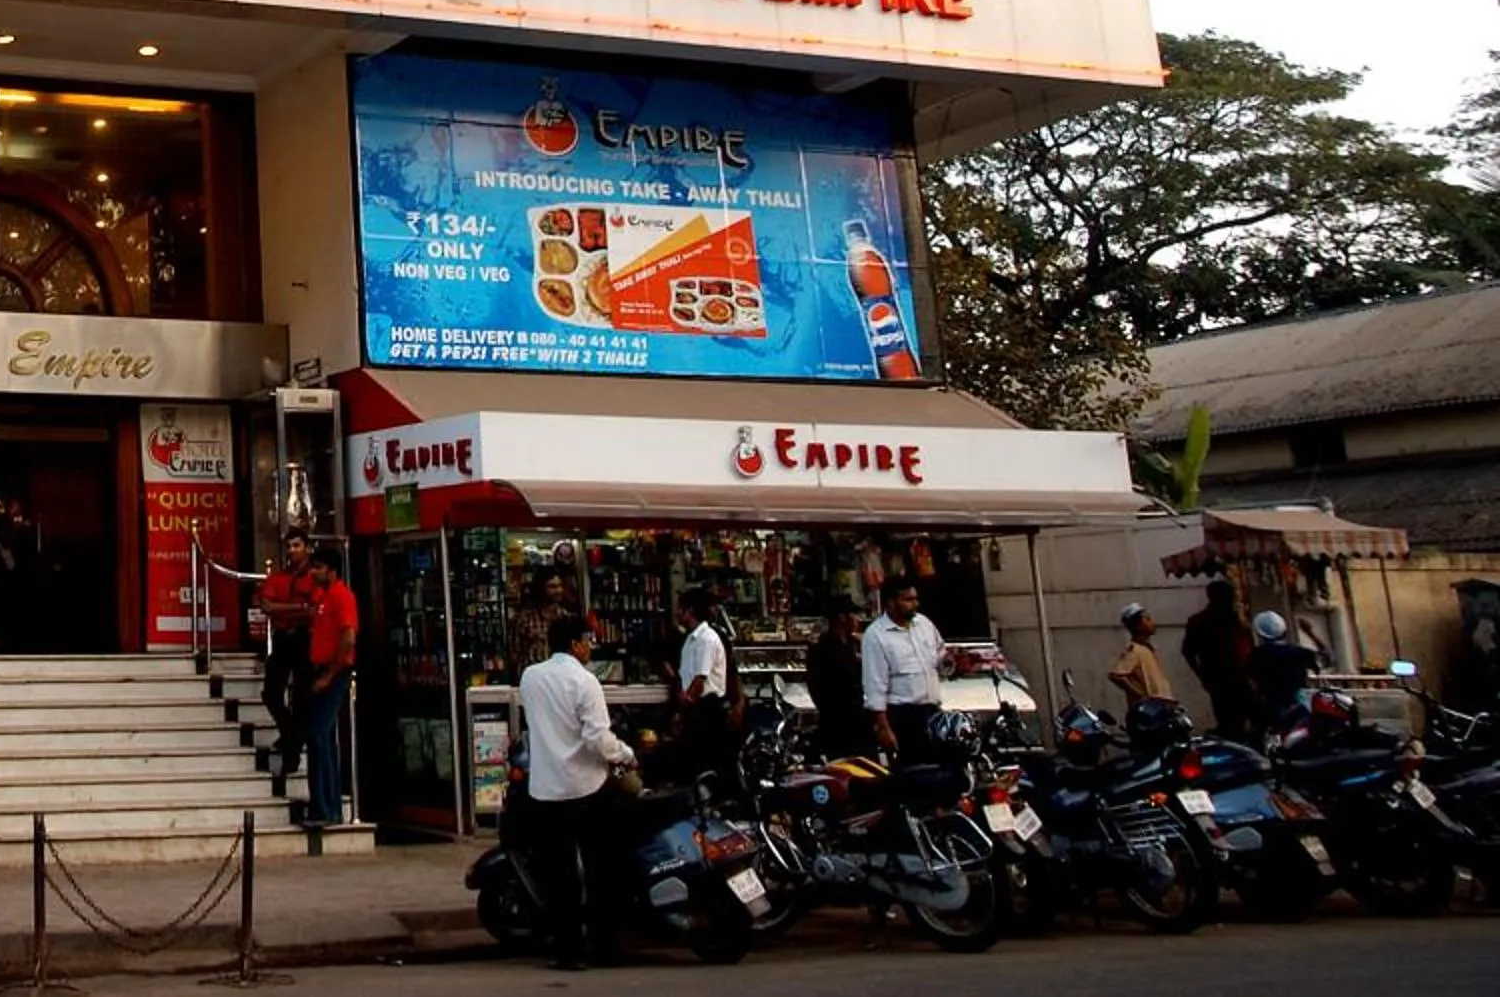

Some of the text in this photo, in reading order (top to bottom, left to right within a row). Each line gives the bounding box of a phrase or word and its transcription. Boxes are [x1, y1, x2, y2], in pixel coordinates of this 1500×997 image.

[595, 109, 749, 168] EMPIRE
[474, 170, 615, 196] INTRODUCING
[619, 180, 671, 200] TAKE
[687, 186, 741, 204] AWAY
[745, 190, 802, 209] THALI
[427, 240, 485, 260] ONLY
[393, 261, 430, 280] NON
[433, 264, 467, 280] VEG
[479, 266, 511, 283] VEG
[390, 342, 421, 358] GET
[426, 344, 437, 359] A
[441, 344, 487, 360] PEPSI
[596, 350, 649, 367] THALIS
[391, 326, 437, 343] HOME
[441, 328, 514, 345] DELIVERY
[568, 334, 586, 347] 40
[590, 335, 606, 348] 41
[611, 335, 627, 349] 41
[631, 336, 647, 350] 41
[9, 330, 154, 390] Empire
[386, 436, 473, 478] EMPIRE
[774, 428, 923, 485] EMPIRE
